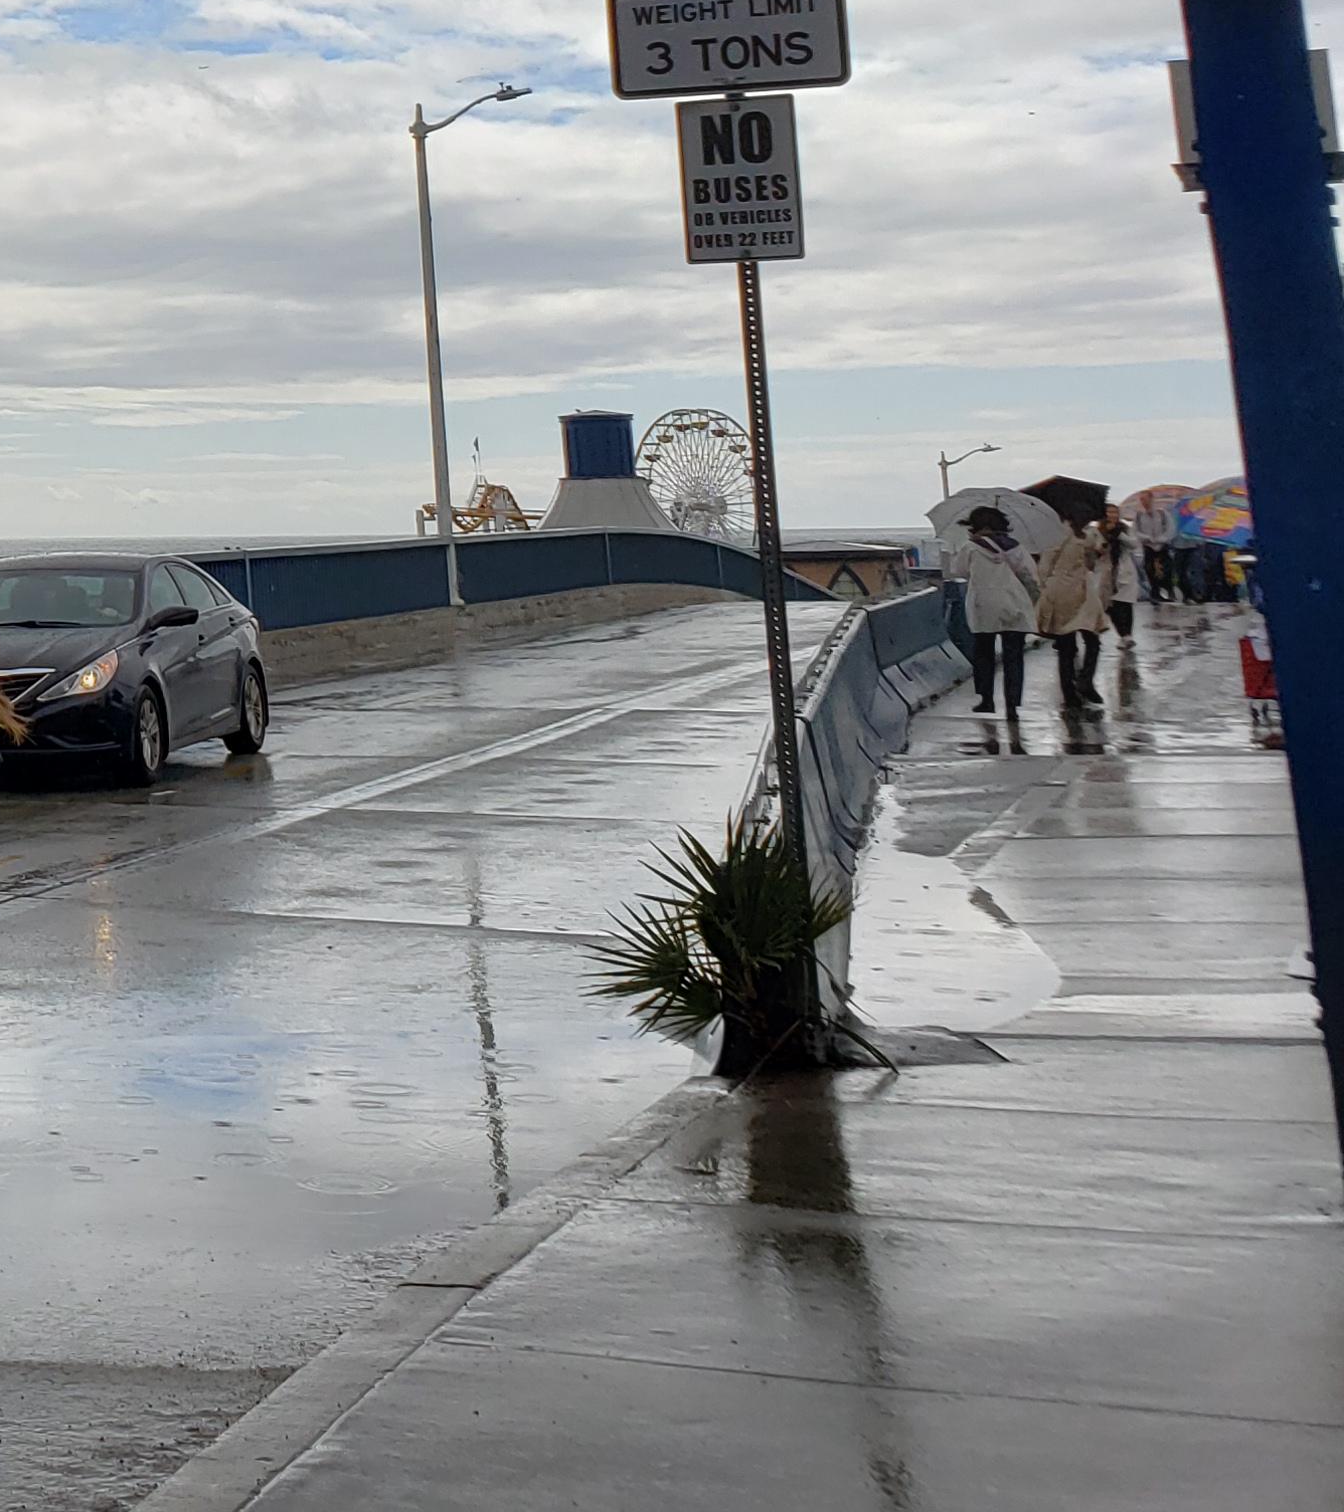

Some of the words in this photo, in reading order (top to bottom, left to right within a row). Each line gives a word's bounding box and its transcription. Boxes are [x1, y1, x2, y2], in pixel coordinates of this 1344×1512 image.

[632, 0, 734, 26] WEIGHT
[645, 41, 674, 75] 3
[691, 31, 813, 72] TONS
[700, 110, 773, 166] NO
[693, 174, 789, 204] BUSES
[719, 208, 793, 226] VEHICLES
[694, 233, 733, 249] OVER
[738, 232, 758, 247] 22
[762, 230, 794, 246] FEET
